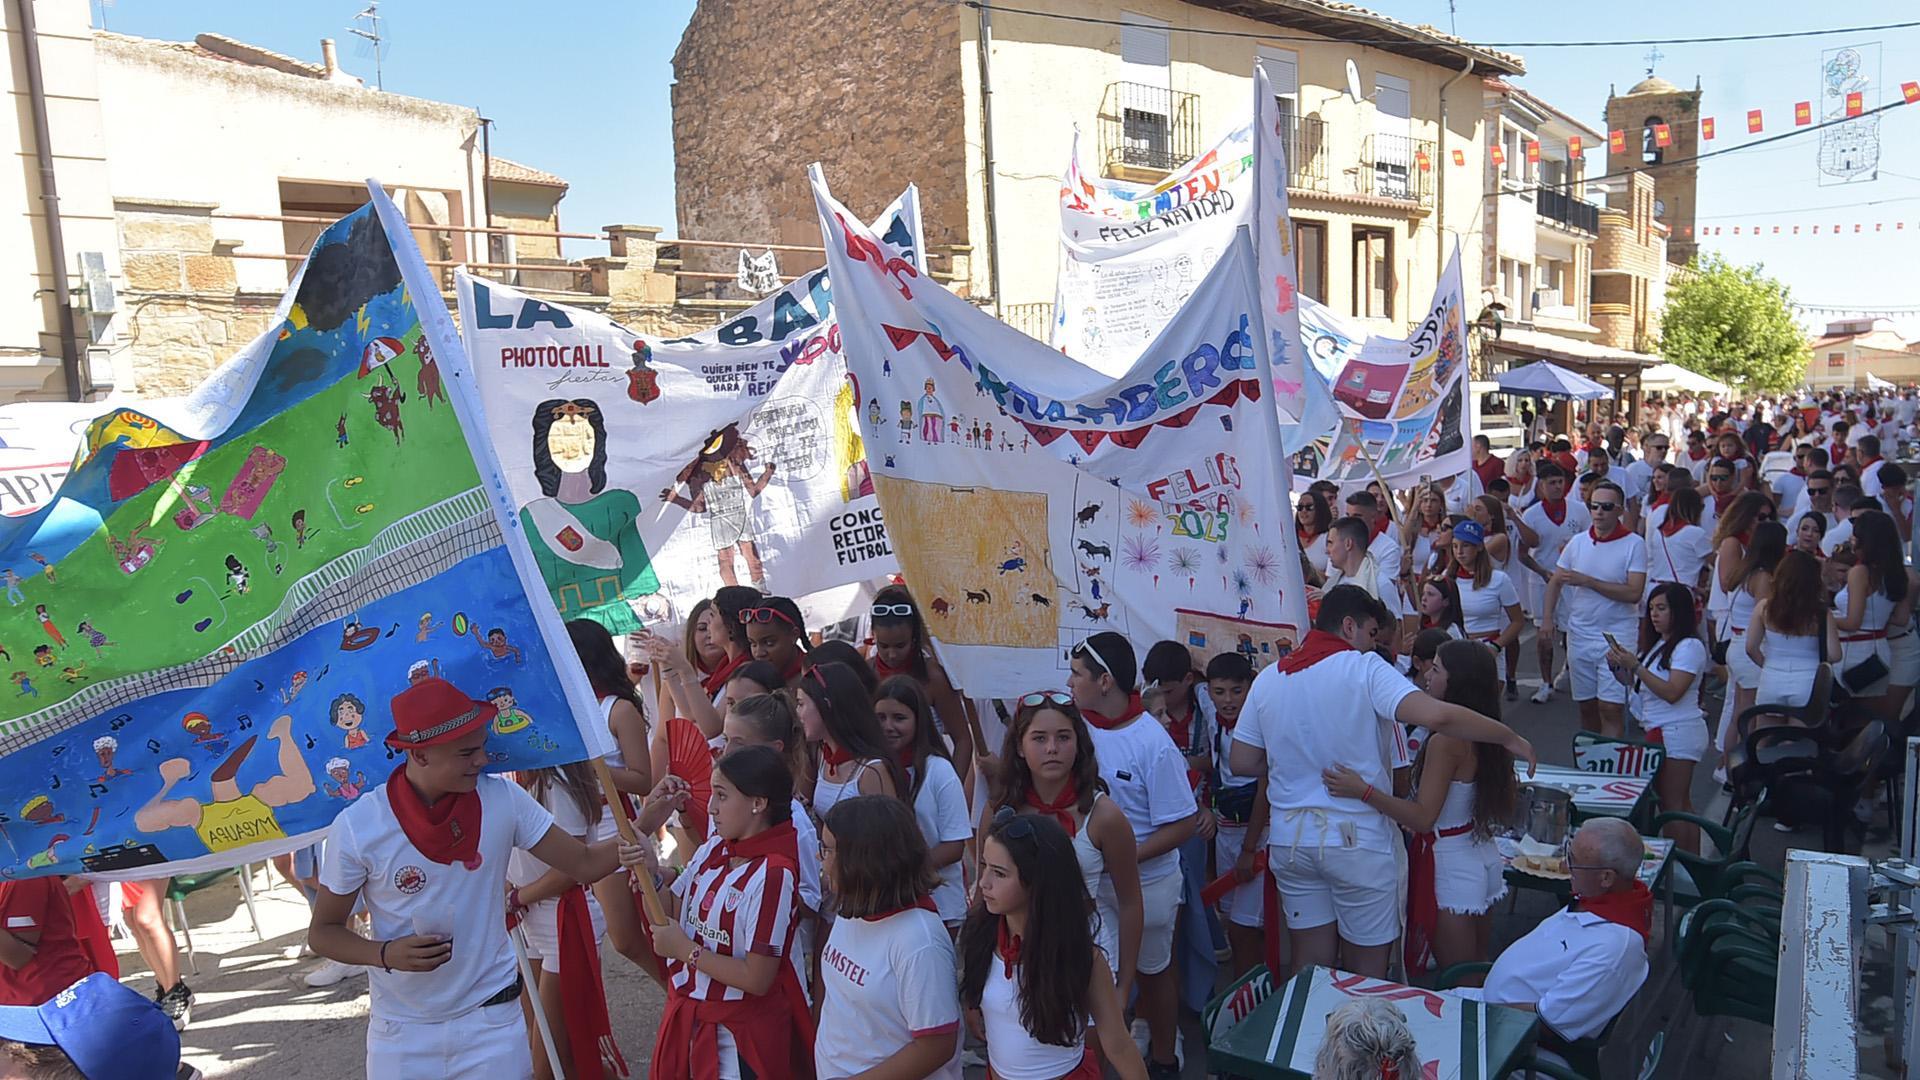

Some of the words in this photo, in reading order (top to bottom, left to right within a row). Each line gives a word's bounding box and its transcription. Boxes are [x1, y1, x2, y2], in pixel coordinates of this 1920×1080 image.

[1159, 189, 1234, 226] NAVIDAD
[473, 280, 573, 329] LA
[501, 344, 610, 368] PHOTOCALL
[762, 361, 775, 370] TE
[706, 373, 741, 384] QUIERE
[744, 372, 757, 382] TE
[1166, 511, 1230, 543] 2023
[837, 541, 893, 566] FUTBOL
[822, 943, 866, 987] AMSTEL
